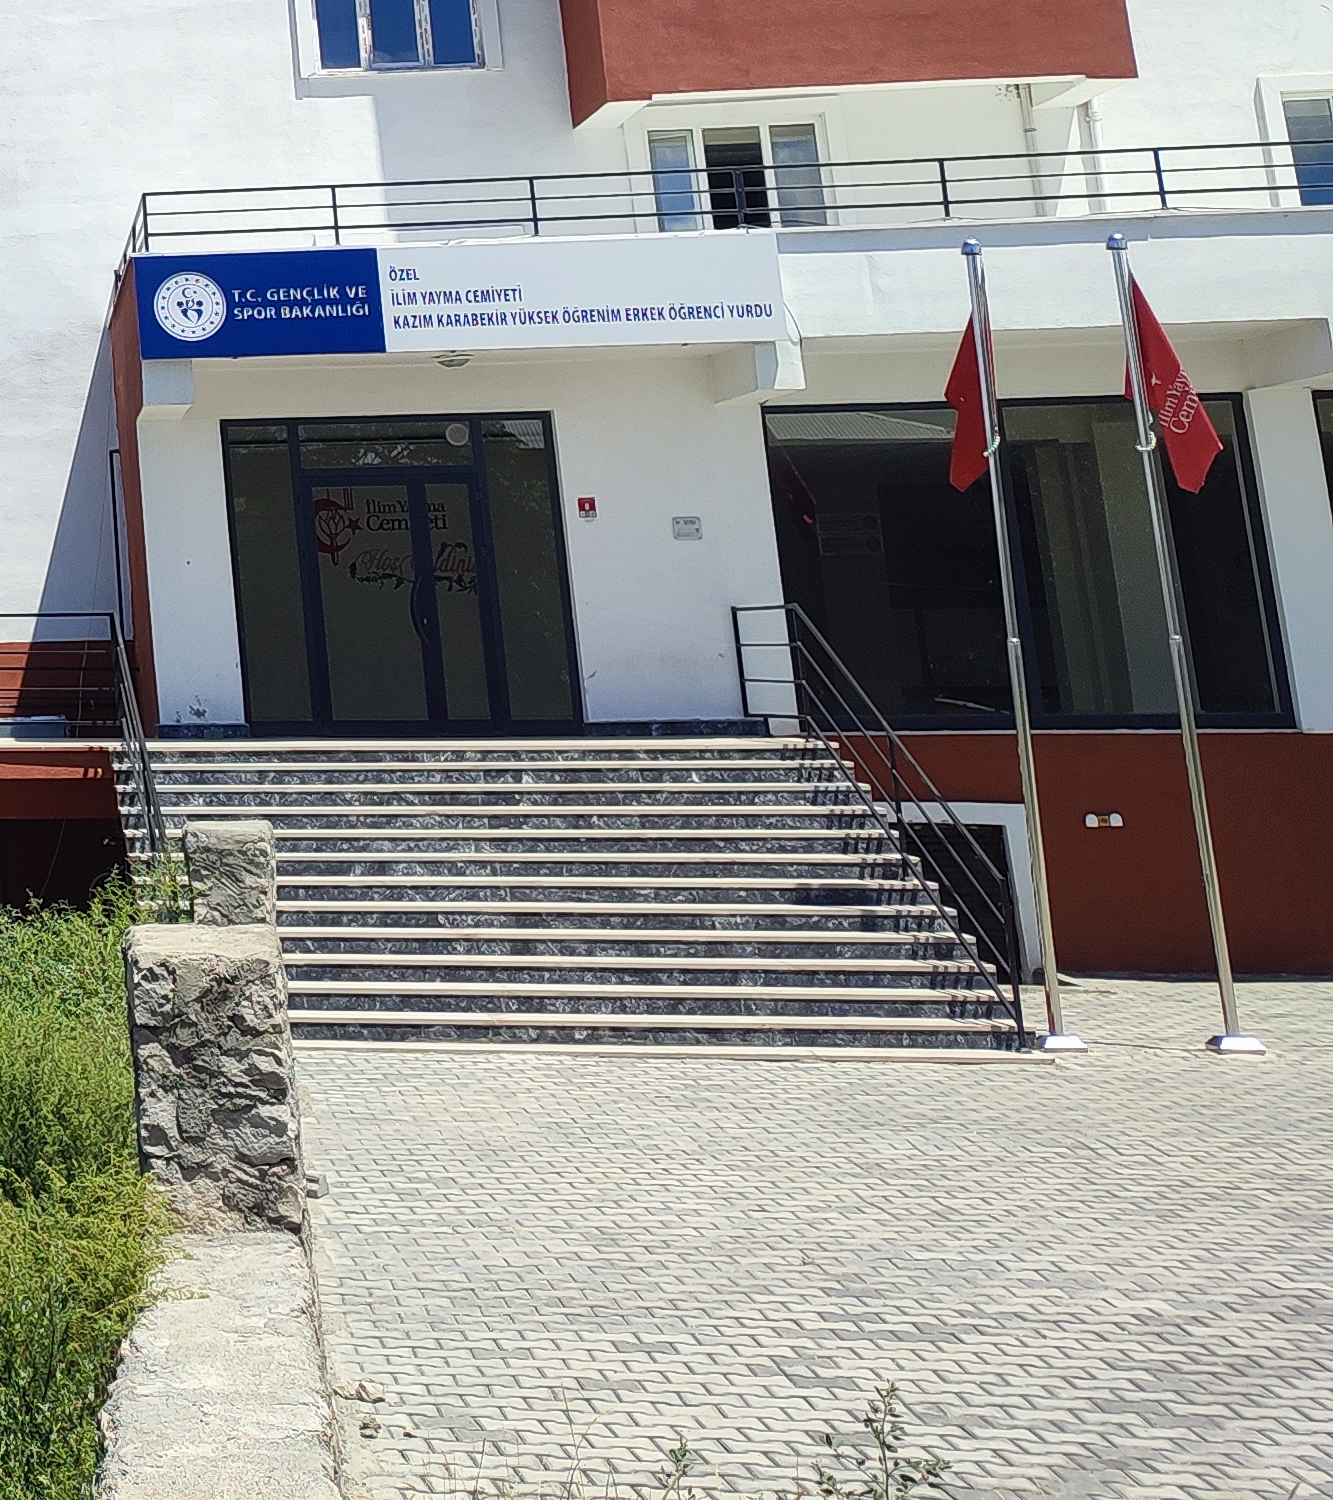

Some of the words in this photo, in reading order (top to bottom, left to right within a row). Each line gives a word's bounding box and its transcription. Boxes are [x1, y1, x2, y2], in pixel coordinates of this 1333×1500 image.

[388, 265, 420, 281] ÖZEL
[232, 289, 263, 303] T.C.
[266, 284, 341, 303] GENÇLİK
[345, 285, 368, 299] VE
[389, 289, 418, 307] İLİM
[420, 289, 462, 306] YAYMA
[465, 284, 523, 304] CEMİYETİ
[233, 306, 277, 320] SPOR
[281, 301, 369, 319] BAKANLIĞI
[393, 313, 434, 329] KAZIM
[436, 308, 508, 328] KARABEKİR
[510, 308, 560, 326] YÜKSEK
[562, 305, 622, 324] ÖĞRENİM
[625, 306, 666, 322] ERKEK
[668, 301, 725, 320] ÖĞRENCİ
[727, 303, 773, 319] YURDU
